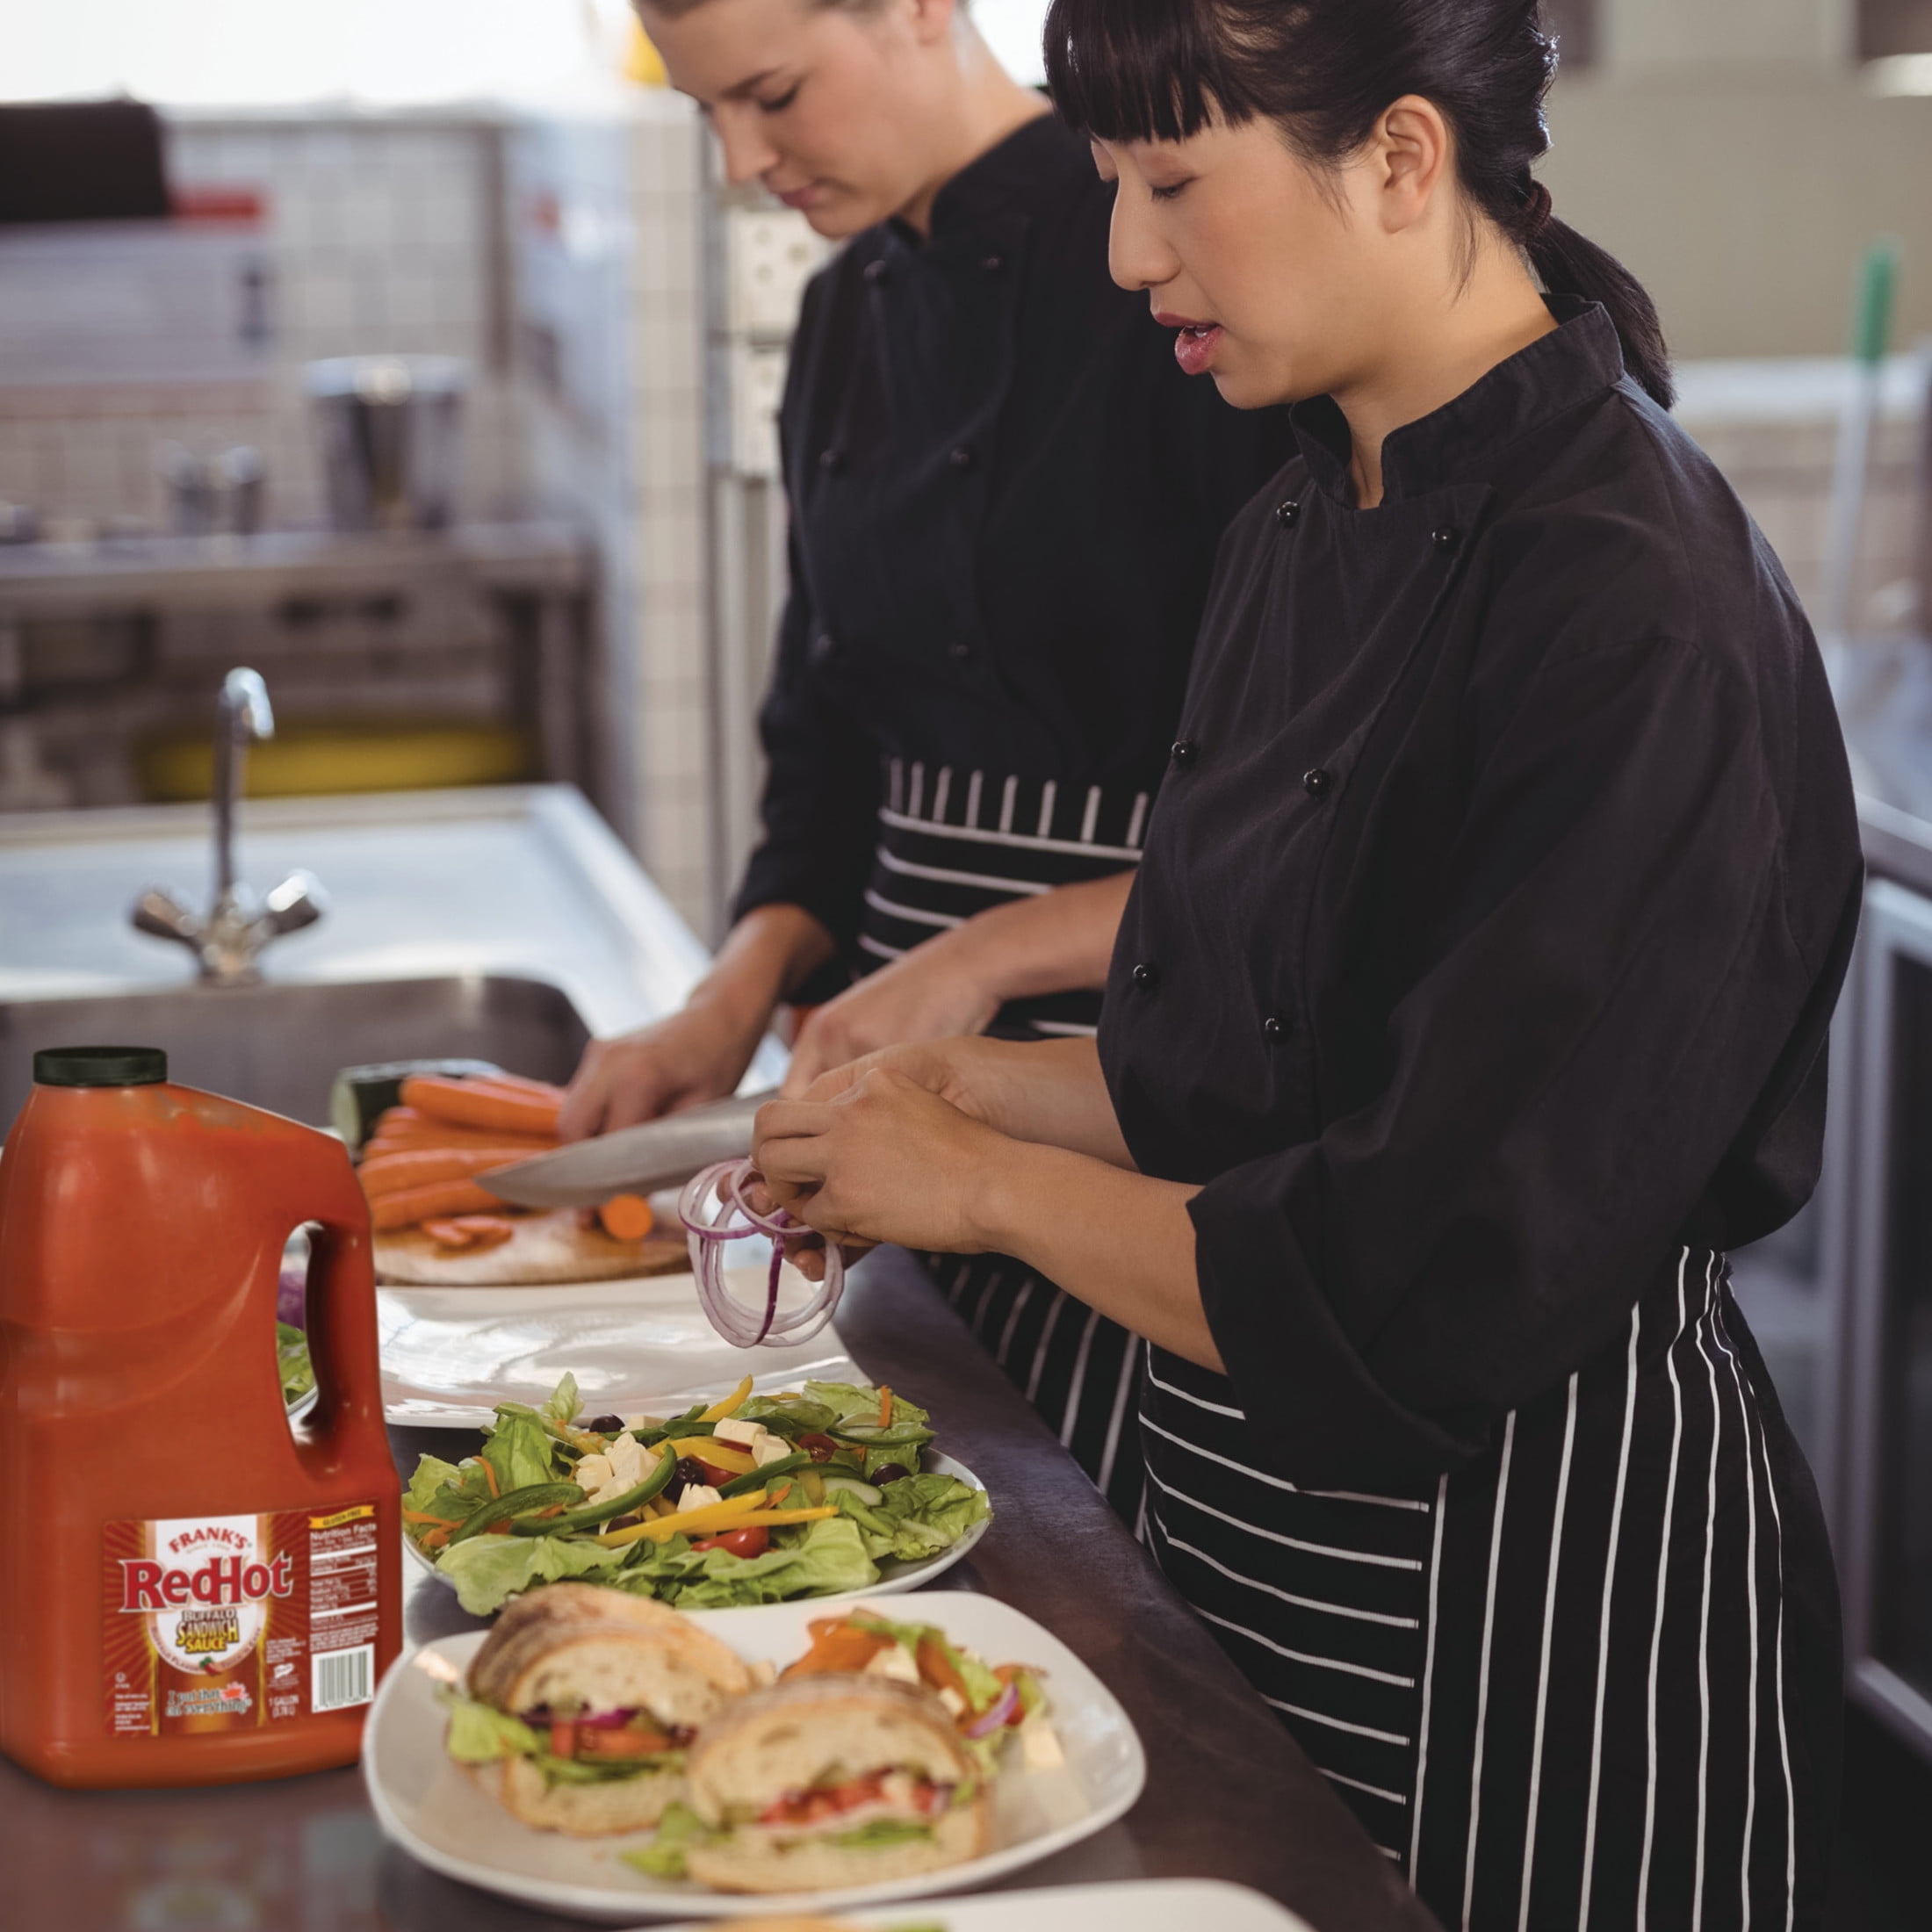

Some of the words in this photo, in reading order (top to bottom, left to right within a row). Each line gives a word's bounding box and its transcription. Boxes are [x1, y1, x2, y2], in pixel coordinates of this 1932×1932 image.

[169, 1526, 249, 1554] FRANK'S
[310, 1528, 351, 1541] Nutrition
[353, 1523, 377, 1535] Facts
[119, 1550, 293, 1612] RedHot
[182, 1608, 237, 1622] BUFFALO
[176, 1618, 239, 1647] SANDWICH
[185, 1636, 227, 1654] SAUCE
